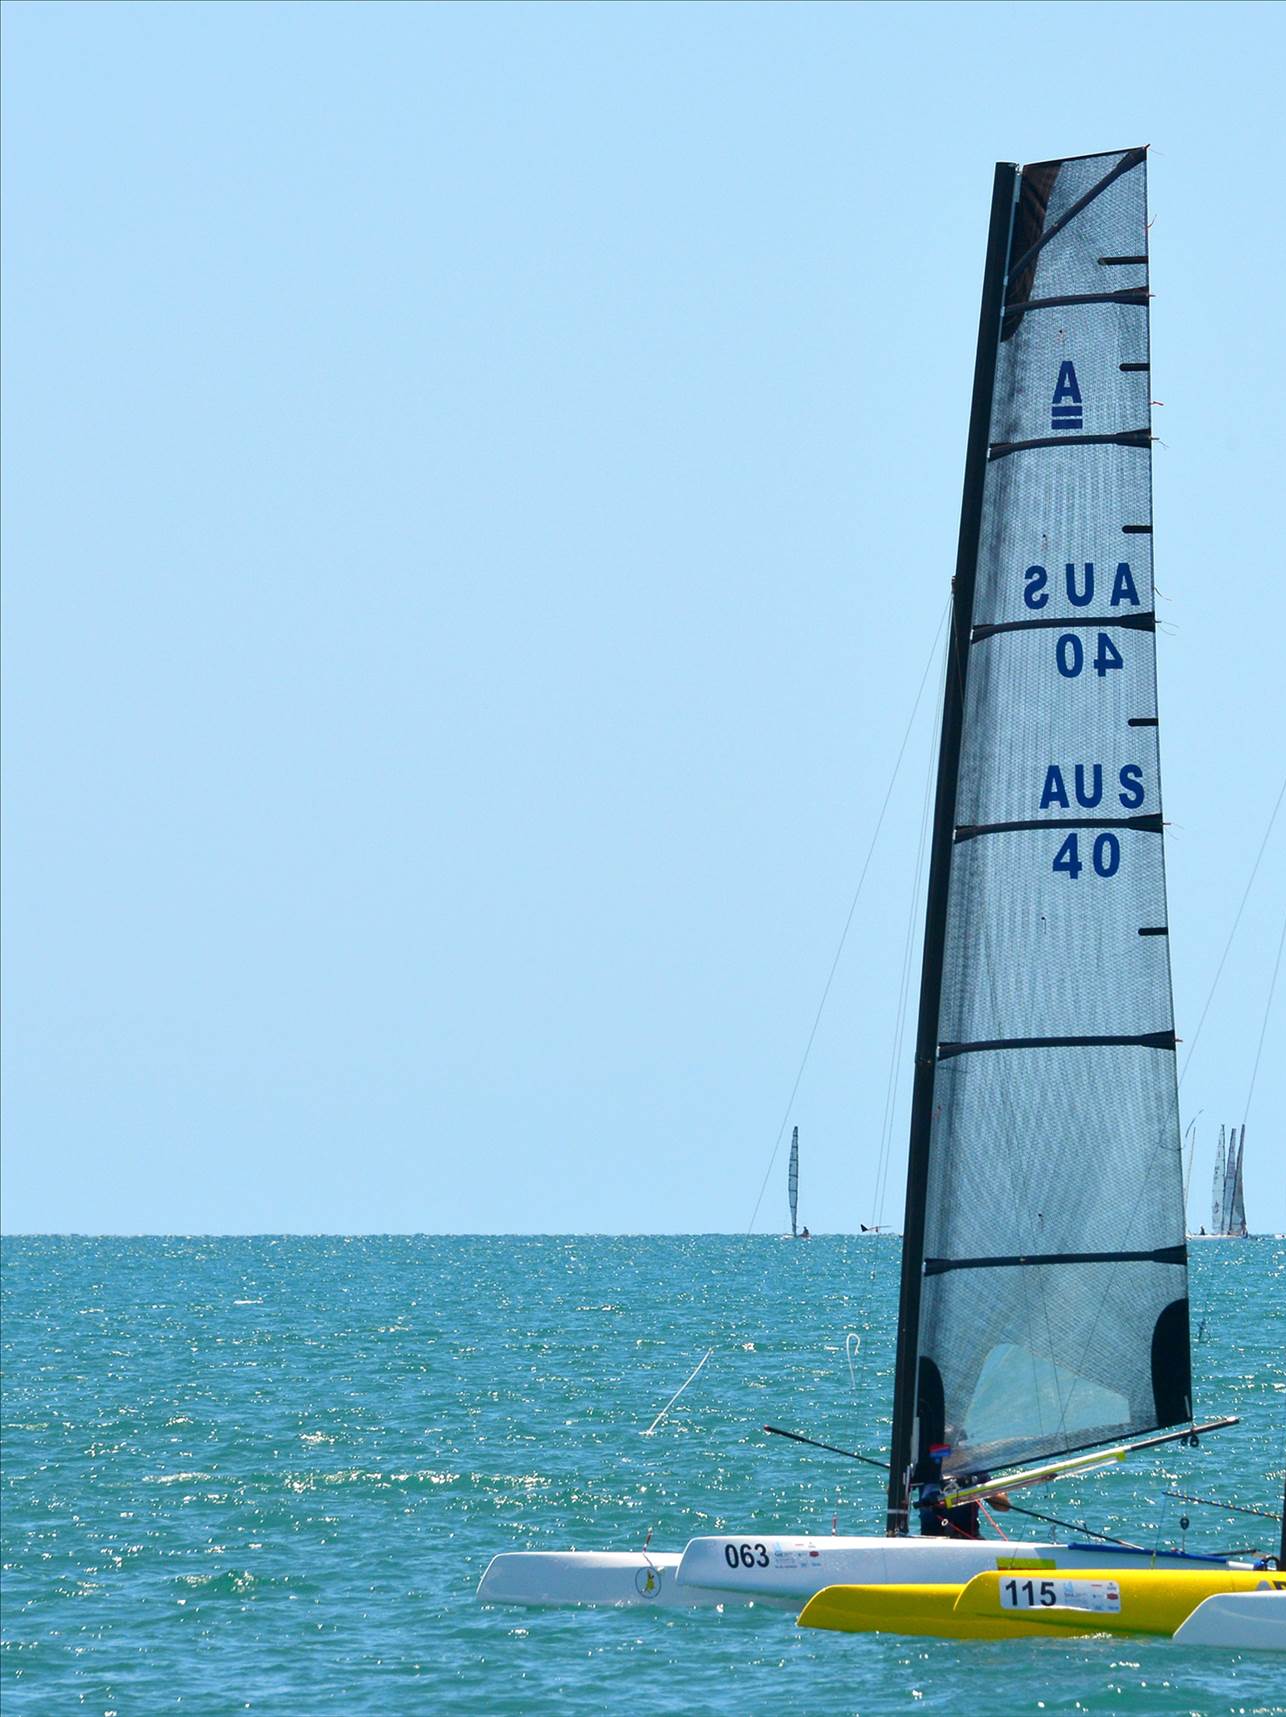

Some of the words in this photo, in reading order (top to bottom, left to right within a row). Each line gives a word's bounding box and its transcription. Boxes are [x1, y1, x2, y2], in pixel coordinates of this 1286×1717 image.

[1052, 361, 1083, 404] A
[1040, 764, 1145, 809] AUS
[1052, 832, 1121, 879] 40
[724, 1543, 770, 1569] 063
[1005, 1580, 1057, 1607] 115
